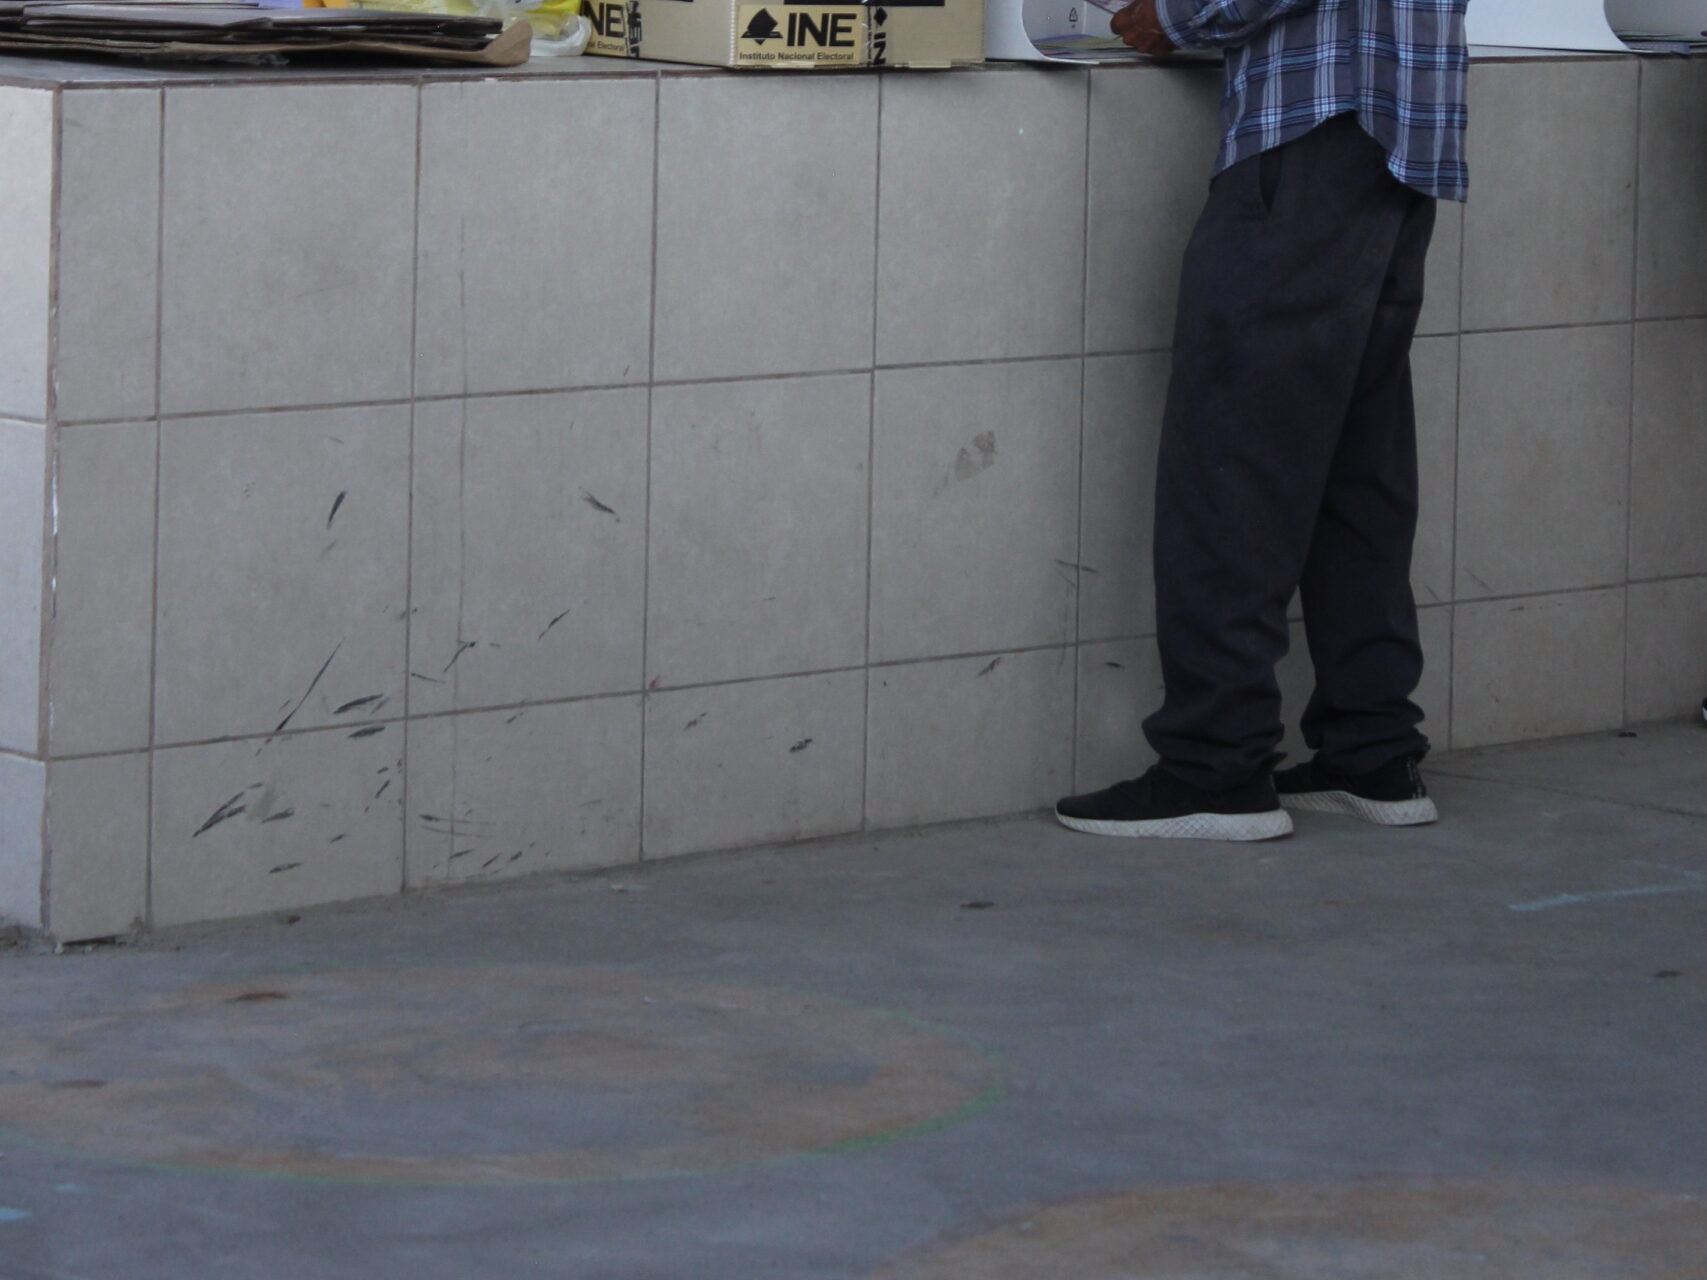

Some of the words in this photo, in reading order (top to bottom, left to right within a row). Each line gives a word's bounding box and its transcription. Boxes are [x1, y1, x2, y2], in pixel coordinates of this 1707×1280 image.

[582, 0, 625, 38] NE
[786, 12, 857, 47] INE
[739, 51, 776, 61] Instituto
[777, 51, 815, 60] Nacional
[817, 51, 854, 61] Electoral
